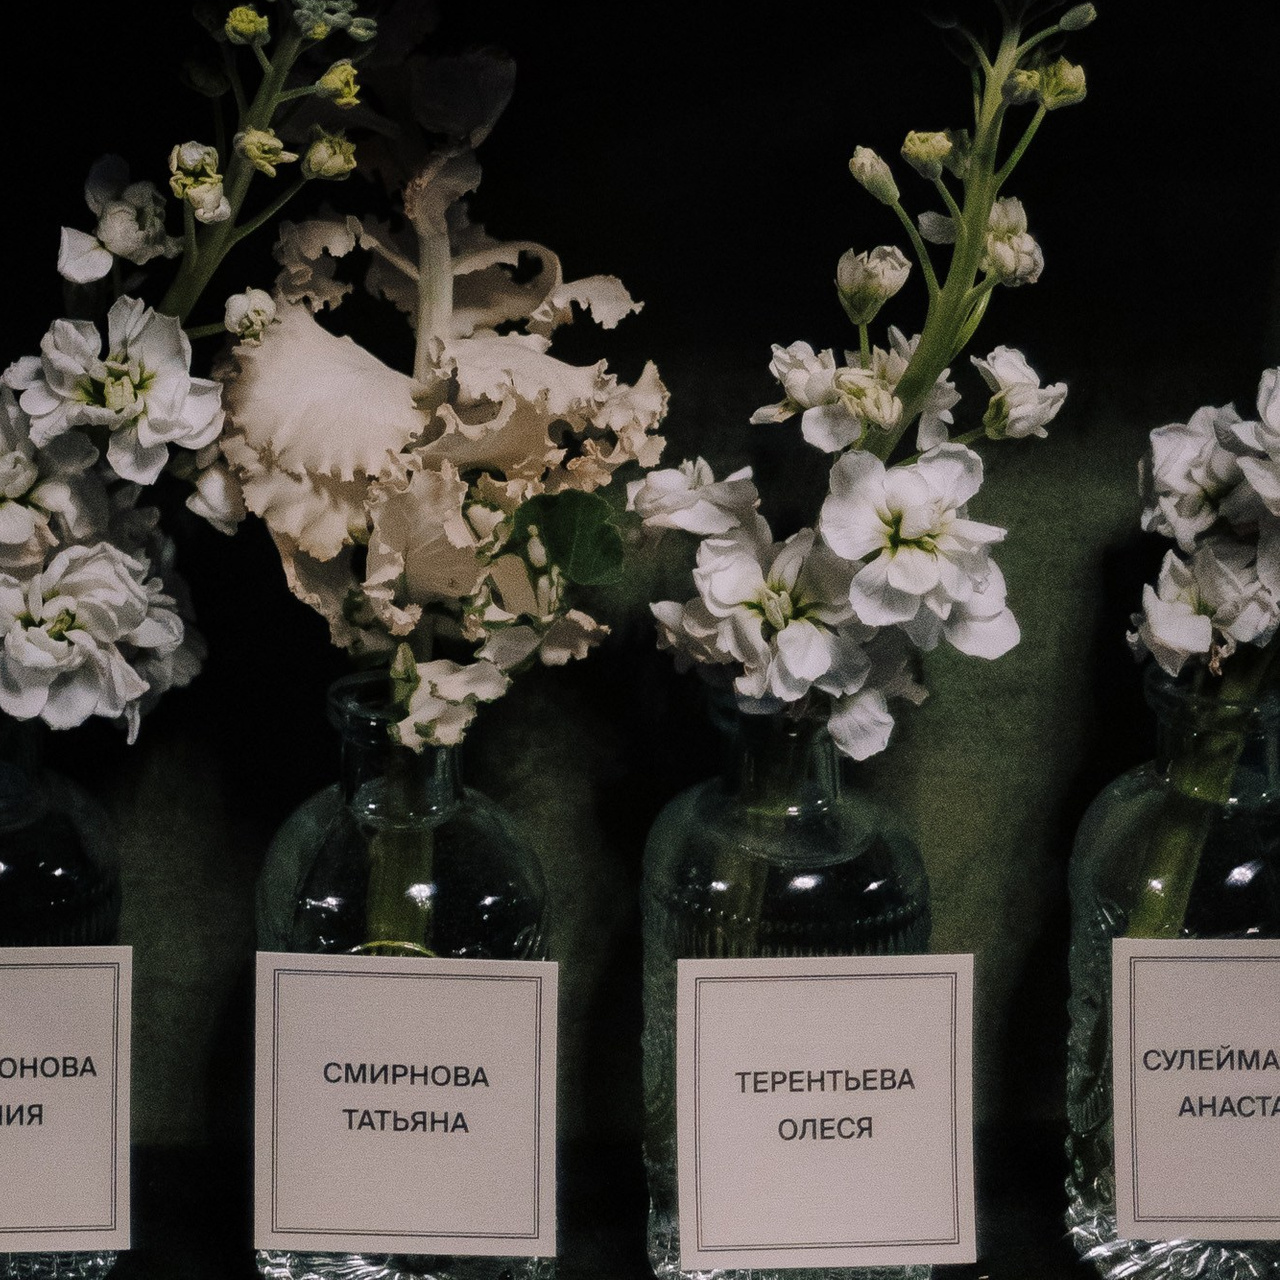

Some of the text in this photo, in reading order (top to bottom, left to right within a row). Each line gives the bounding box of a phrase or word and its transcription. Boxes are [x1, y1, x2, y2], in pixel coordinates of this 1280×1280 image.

[1143, 1044, 1280, 1072] СУЛЕЙМА
[323, 1061, 490, 1088] СМИРНОВА
[734, 1068, 916, 1094] ТЕРЕНТЬЕВА
[341, 1108, 470, 1134] ТАТЬЯНА
[778, 1116, 873, 1141] ОЛЕСЯ
